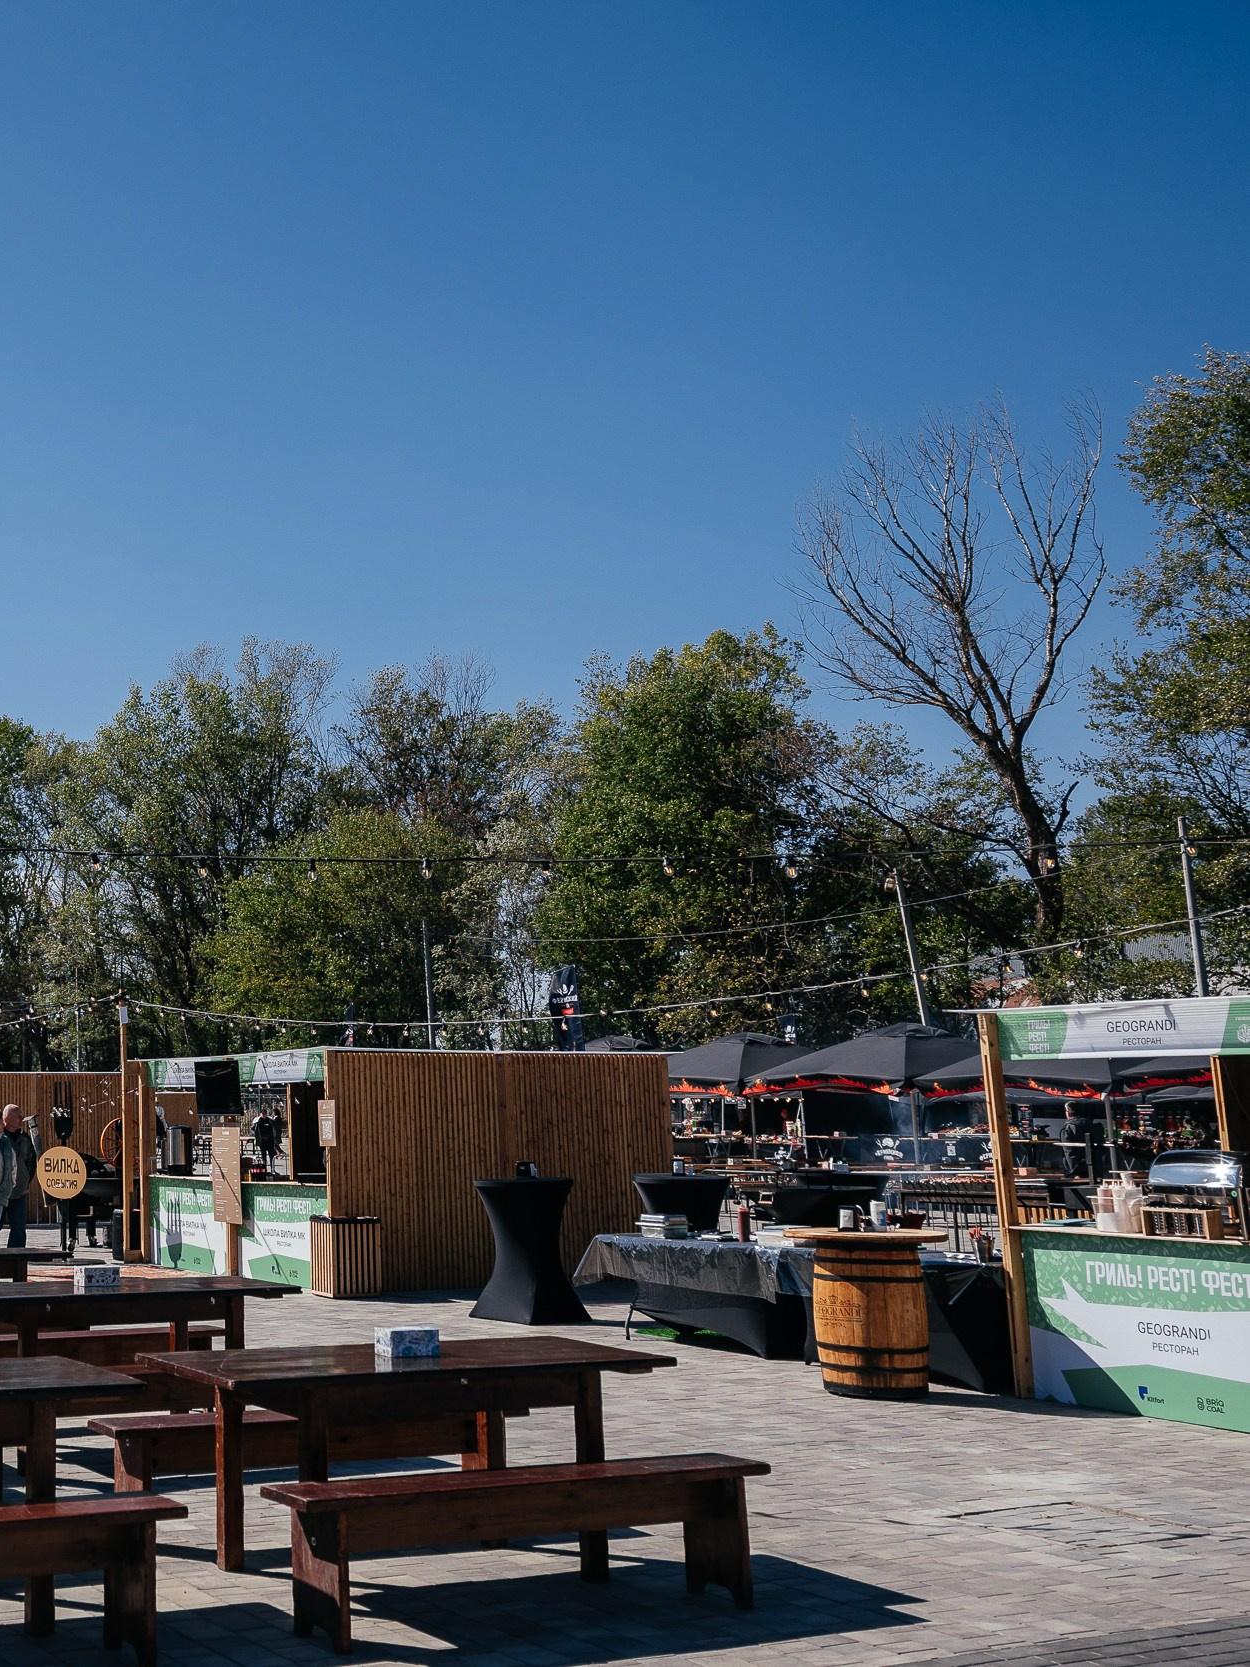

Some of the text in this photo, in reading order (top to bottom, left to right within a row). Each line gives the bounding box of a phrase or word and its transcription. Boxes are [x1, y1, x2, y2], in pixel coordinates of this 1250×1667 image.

[1106, 1019, 1176, 1033] GEOGRANDI
[1028, 1032, 1047, 1042] РЕСТ!
[1122, 1037, 1162, 1046] РЕСТОРАН
[1029, 1043, 1050, 1054] ФЕСТ!
[44, 1157, 80, 1175] ВИЛКА
[46, 1178, 78, 1190] СОБЫТИЯ
[182, 1192, 196, 1206] РЕСТ!
[257, 1198, 312, 1214] ГРИЛЬ! РЕСТ! ФЕСТ!
[1085, 1260, 1143, 1289] ГРИЛЬ!
[1146, 1265, 1197, 1294] РЕСТ!
[815, 1306, 861, 1317] GEOGRANDI
[1137, 1321, 1211, 1341] GEOGRANDI
[1152, 1341, 1199, 1356] РЕСТОРАН
[1206, 1406, 1225, 1414] COAL
